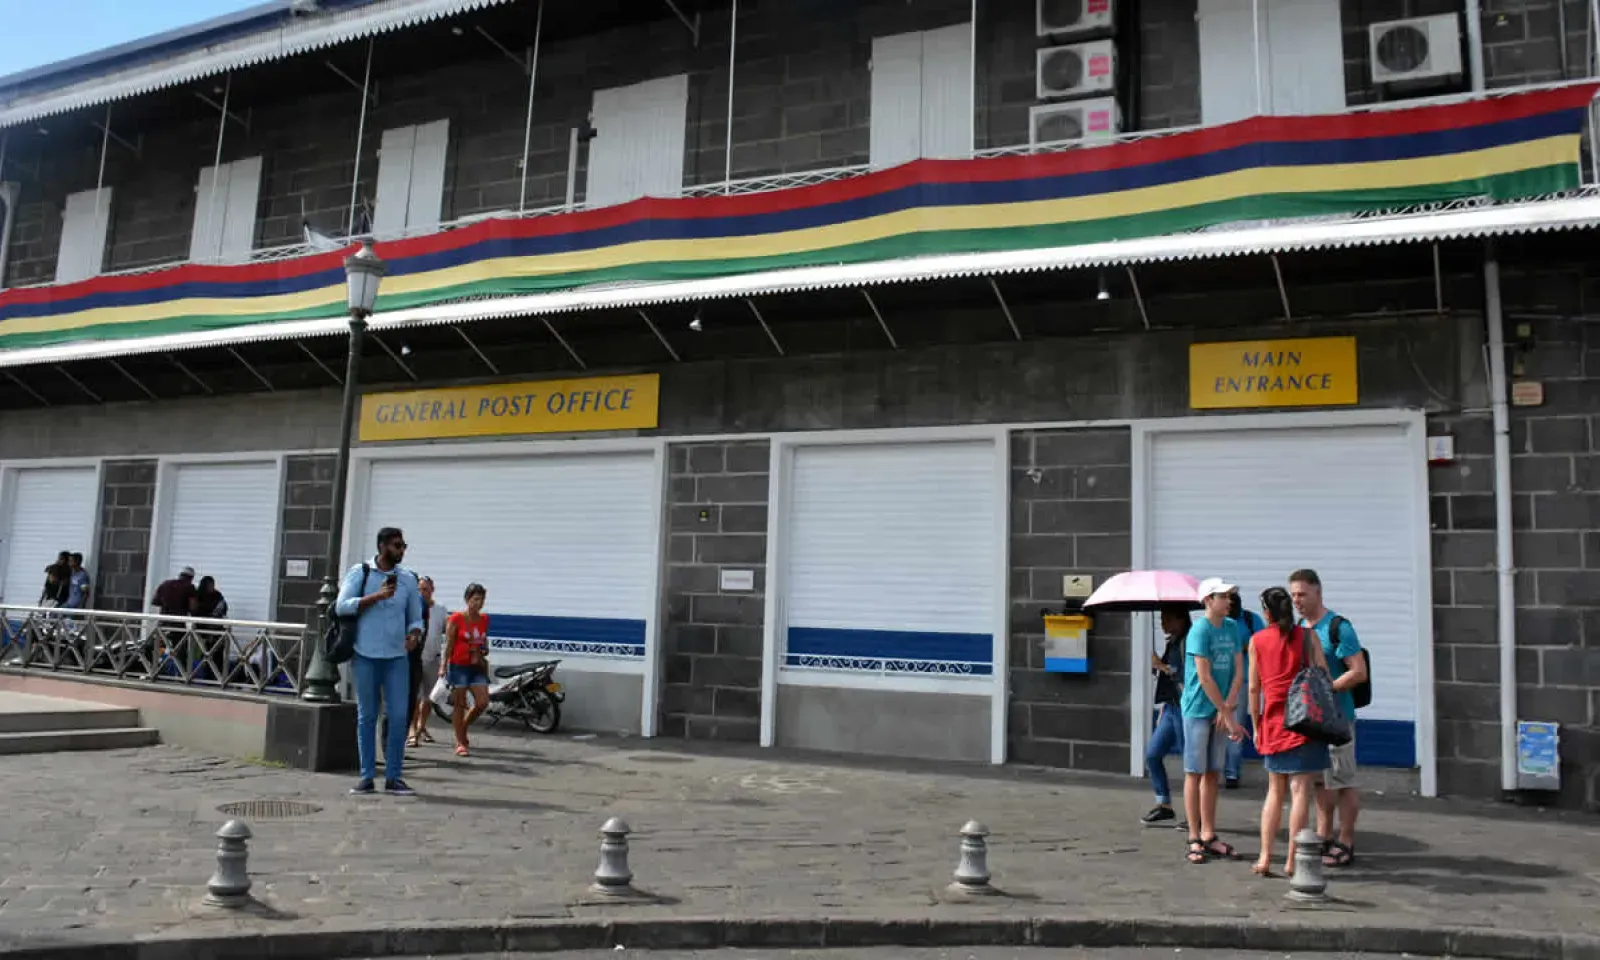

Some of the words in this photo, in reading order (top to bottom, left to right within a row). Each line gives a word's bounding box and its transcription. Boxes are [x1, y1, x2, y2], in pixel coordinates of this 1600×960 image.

[1242, 351, 1302, 368] MAIN
[1214, 373, 1333, 393] ENTRANCE
[376, 400, 467, 424] GENERAL
[477, 394, 537, 417] POST
[546, 388, 636, 413] OFFICE
